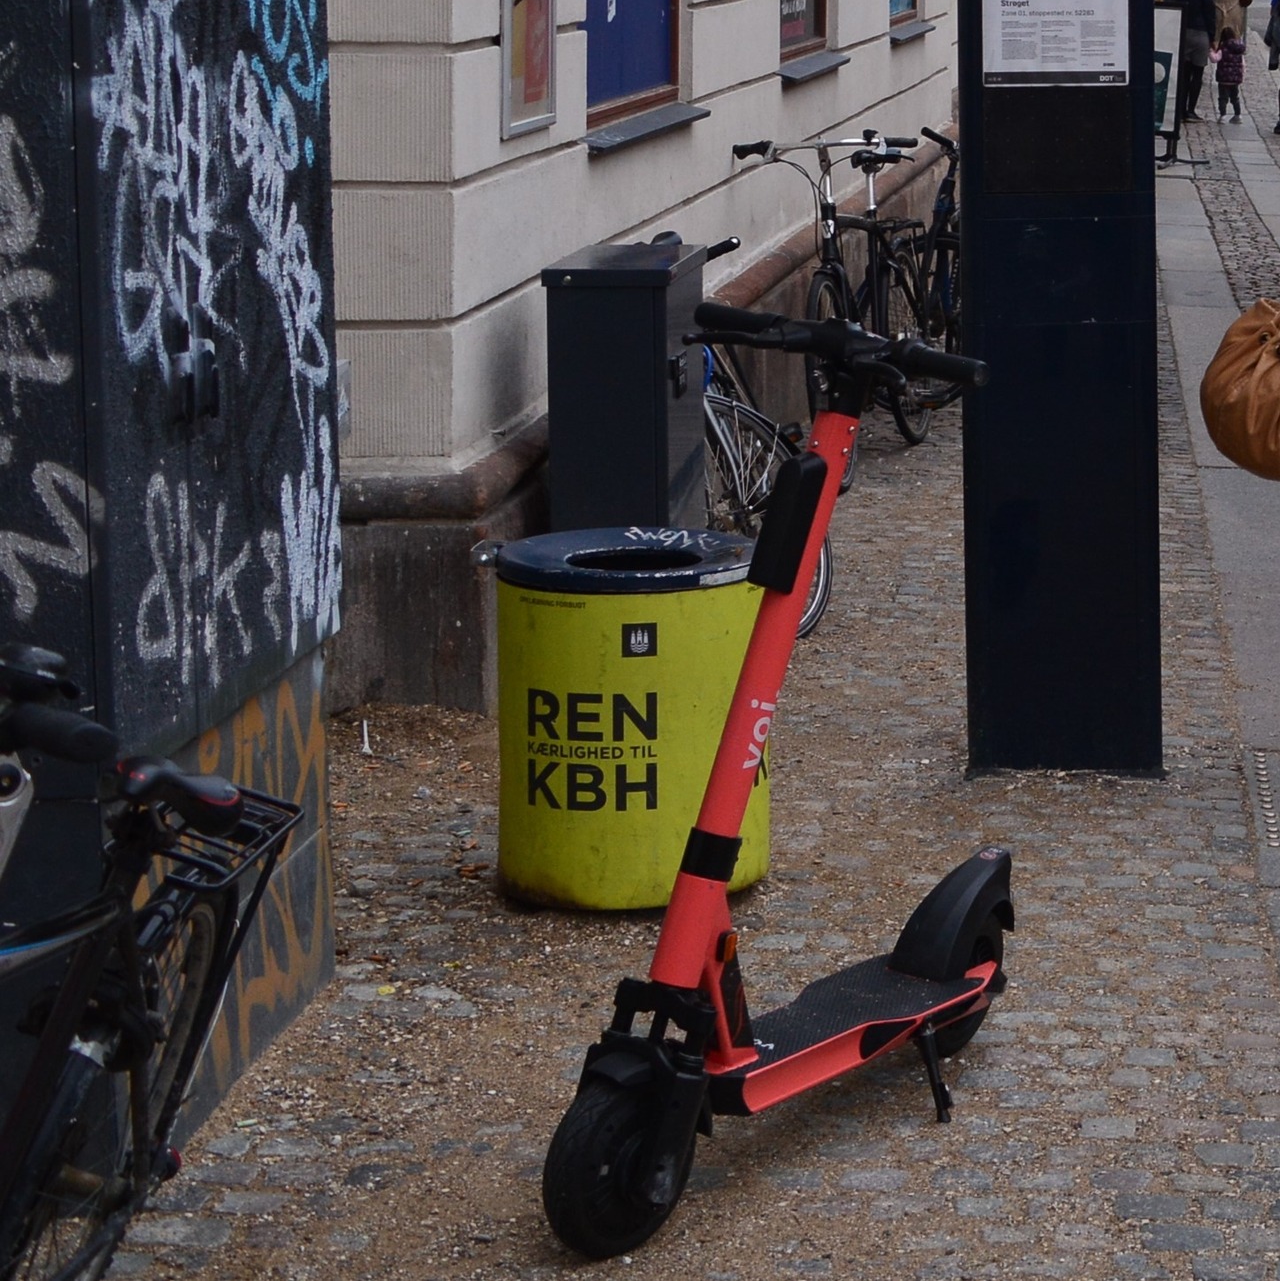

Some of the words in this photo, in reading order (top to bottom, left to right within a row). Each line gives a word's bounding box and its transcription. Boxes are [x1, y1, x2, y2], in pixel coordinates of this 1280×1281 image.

[1001, 0, 1029, 8] Strøget
[527, 688, 658, 742] REN
[527, 741, 624, 760] KÆRLIGHED
[630, 745, 658, 758] TIL
[527, 759, 658, 812] KBH
